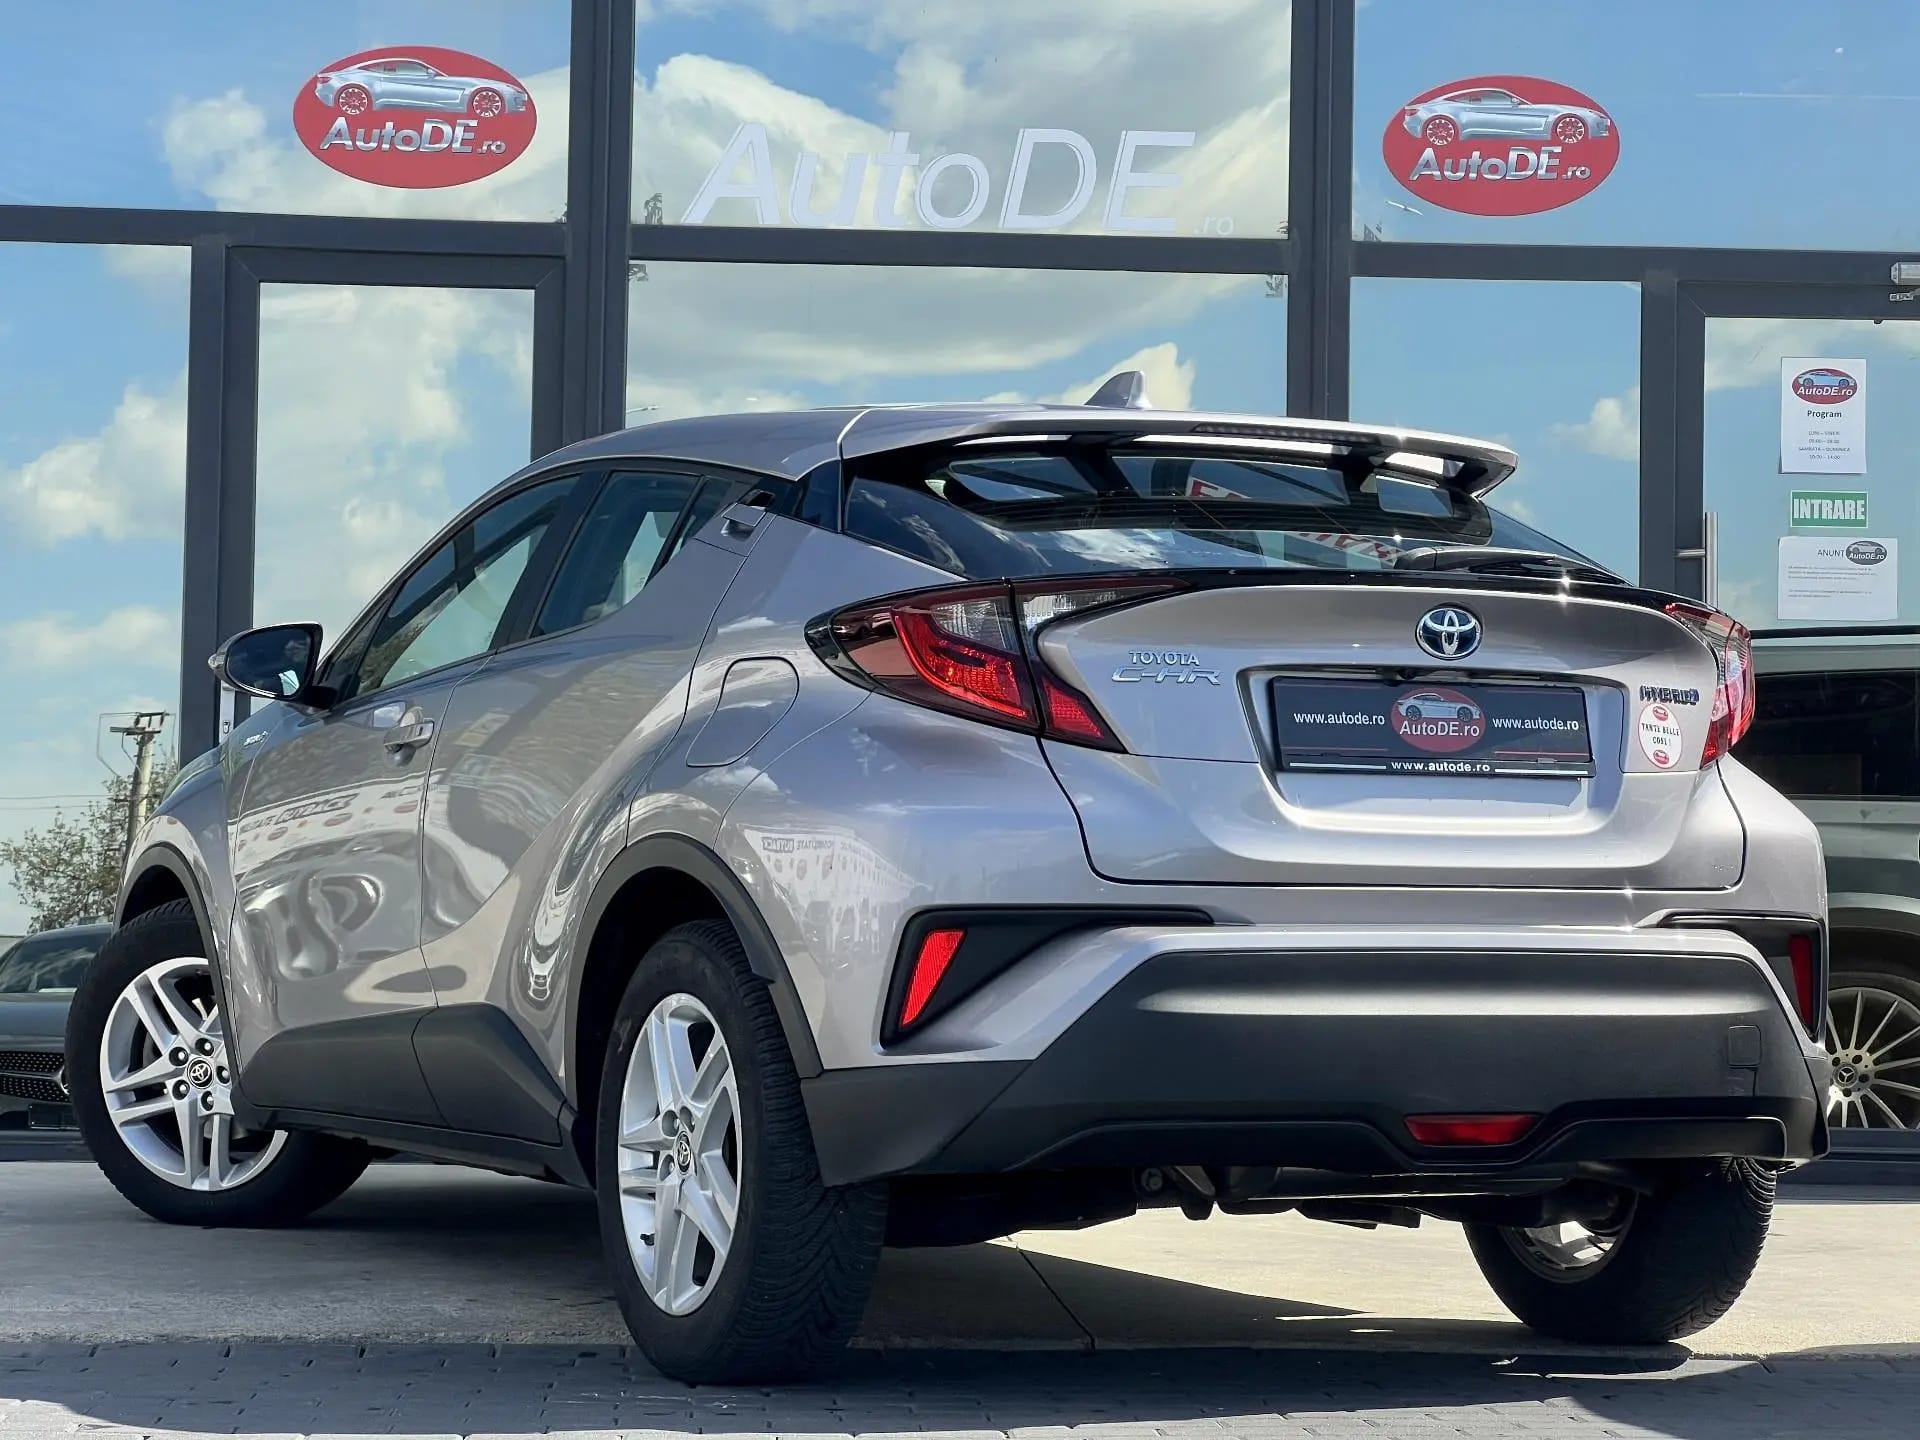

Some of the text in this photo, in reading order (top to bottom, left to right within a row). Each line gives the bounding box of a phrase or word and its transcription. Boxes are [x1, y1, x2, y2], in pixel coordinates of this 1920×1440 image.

[1797, 386, 1853, 396] AutoDE.ro
[1807, 410, 1842, 419] Program
[1793, 499, 1865, 520] INTRARE
[1849, 552, 1885, 560] AutoDE.ro
[1129, 651, 1200, 666] TOYOTA
[1112, 667, 1221, 685] C-HR
[1293, 711, 1386, 726] www.autode.ro
[1492, 715, 1580, 731] www.autode.ro
[1399, 720, 1480, 738] AutoDE.ro
[1391, 760, 1491, 774] www.autode.ro
